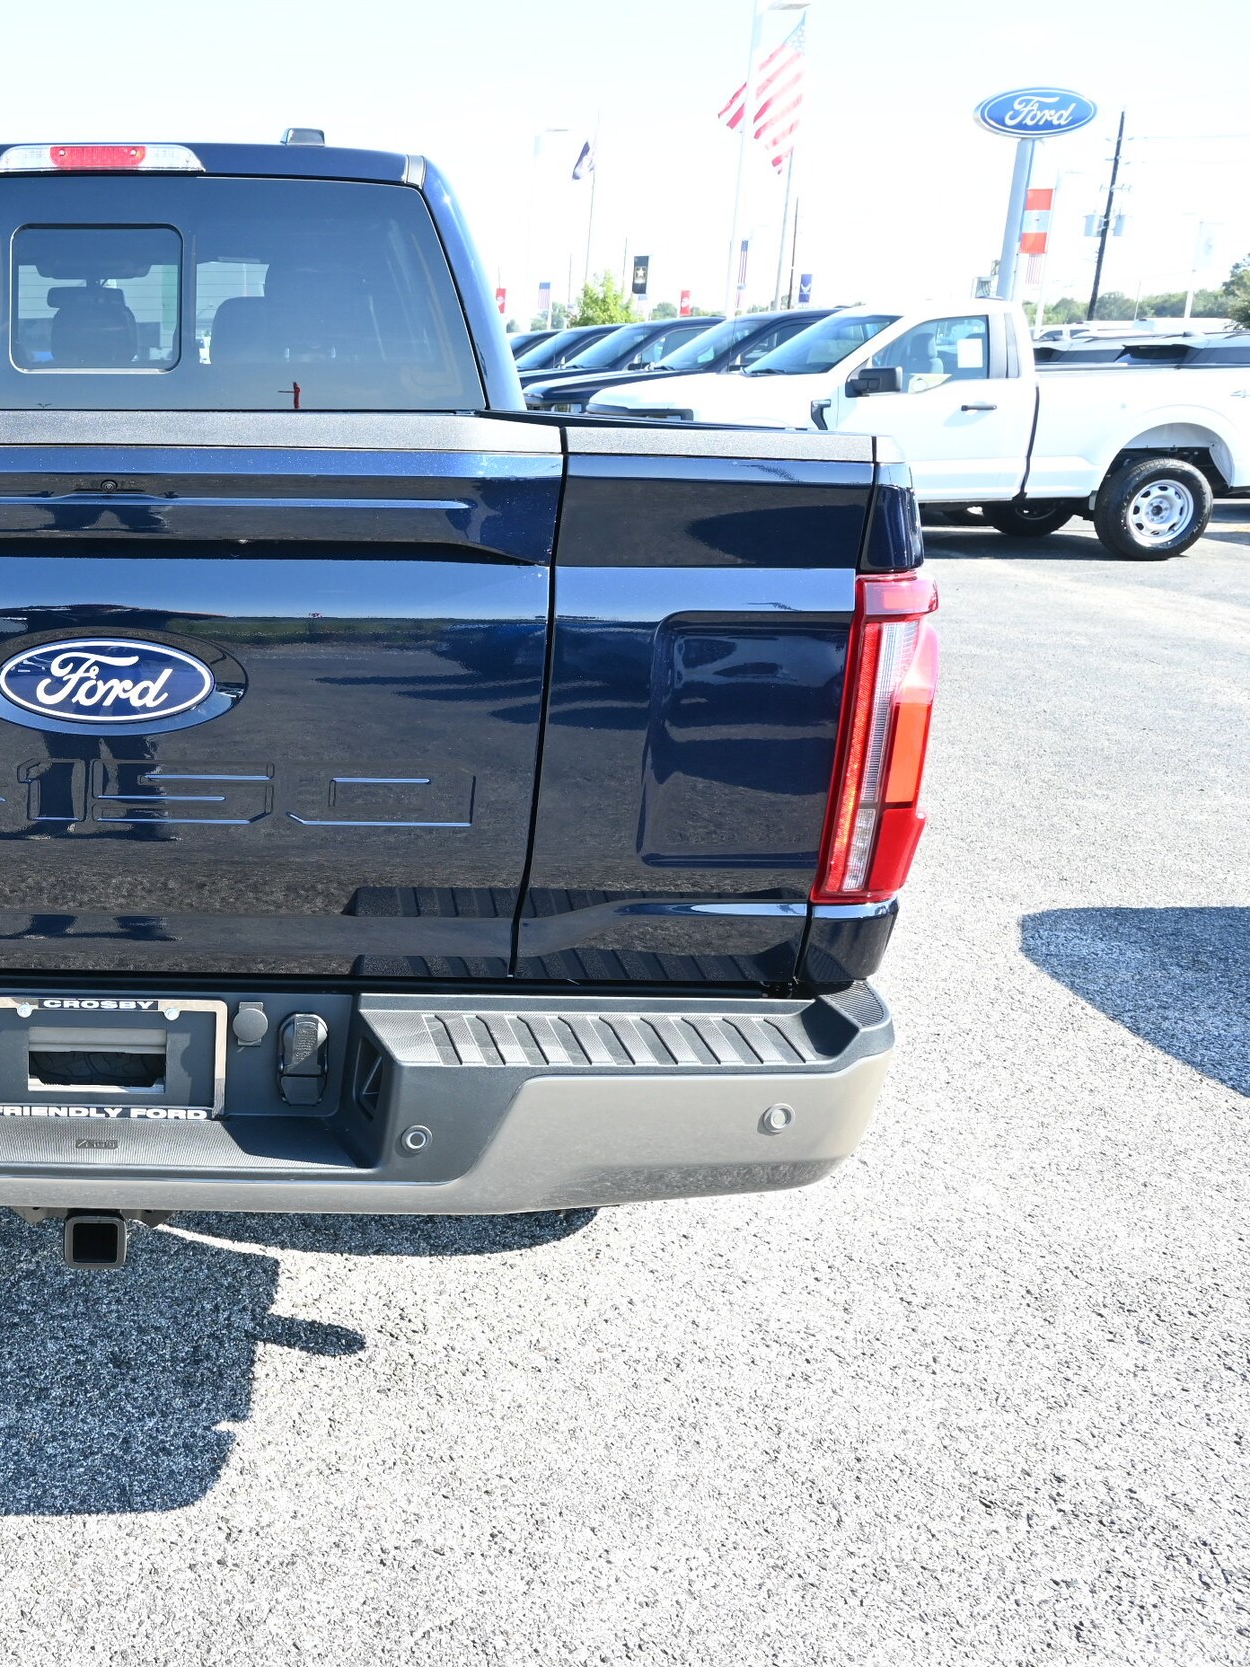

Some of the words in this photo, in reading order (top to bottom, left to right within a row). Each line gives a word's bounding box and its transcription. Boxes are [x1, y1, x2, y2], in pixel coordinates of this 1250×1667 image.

[1004, 95, 1077, 126] Ford
[36, 652, 173, 708] Ford
[42, 1000, 154, 1010] CROSBY
[130, 1108, 208, 1119] FORD
